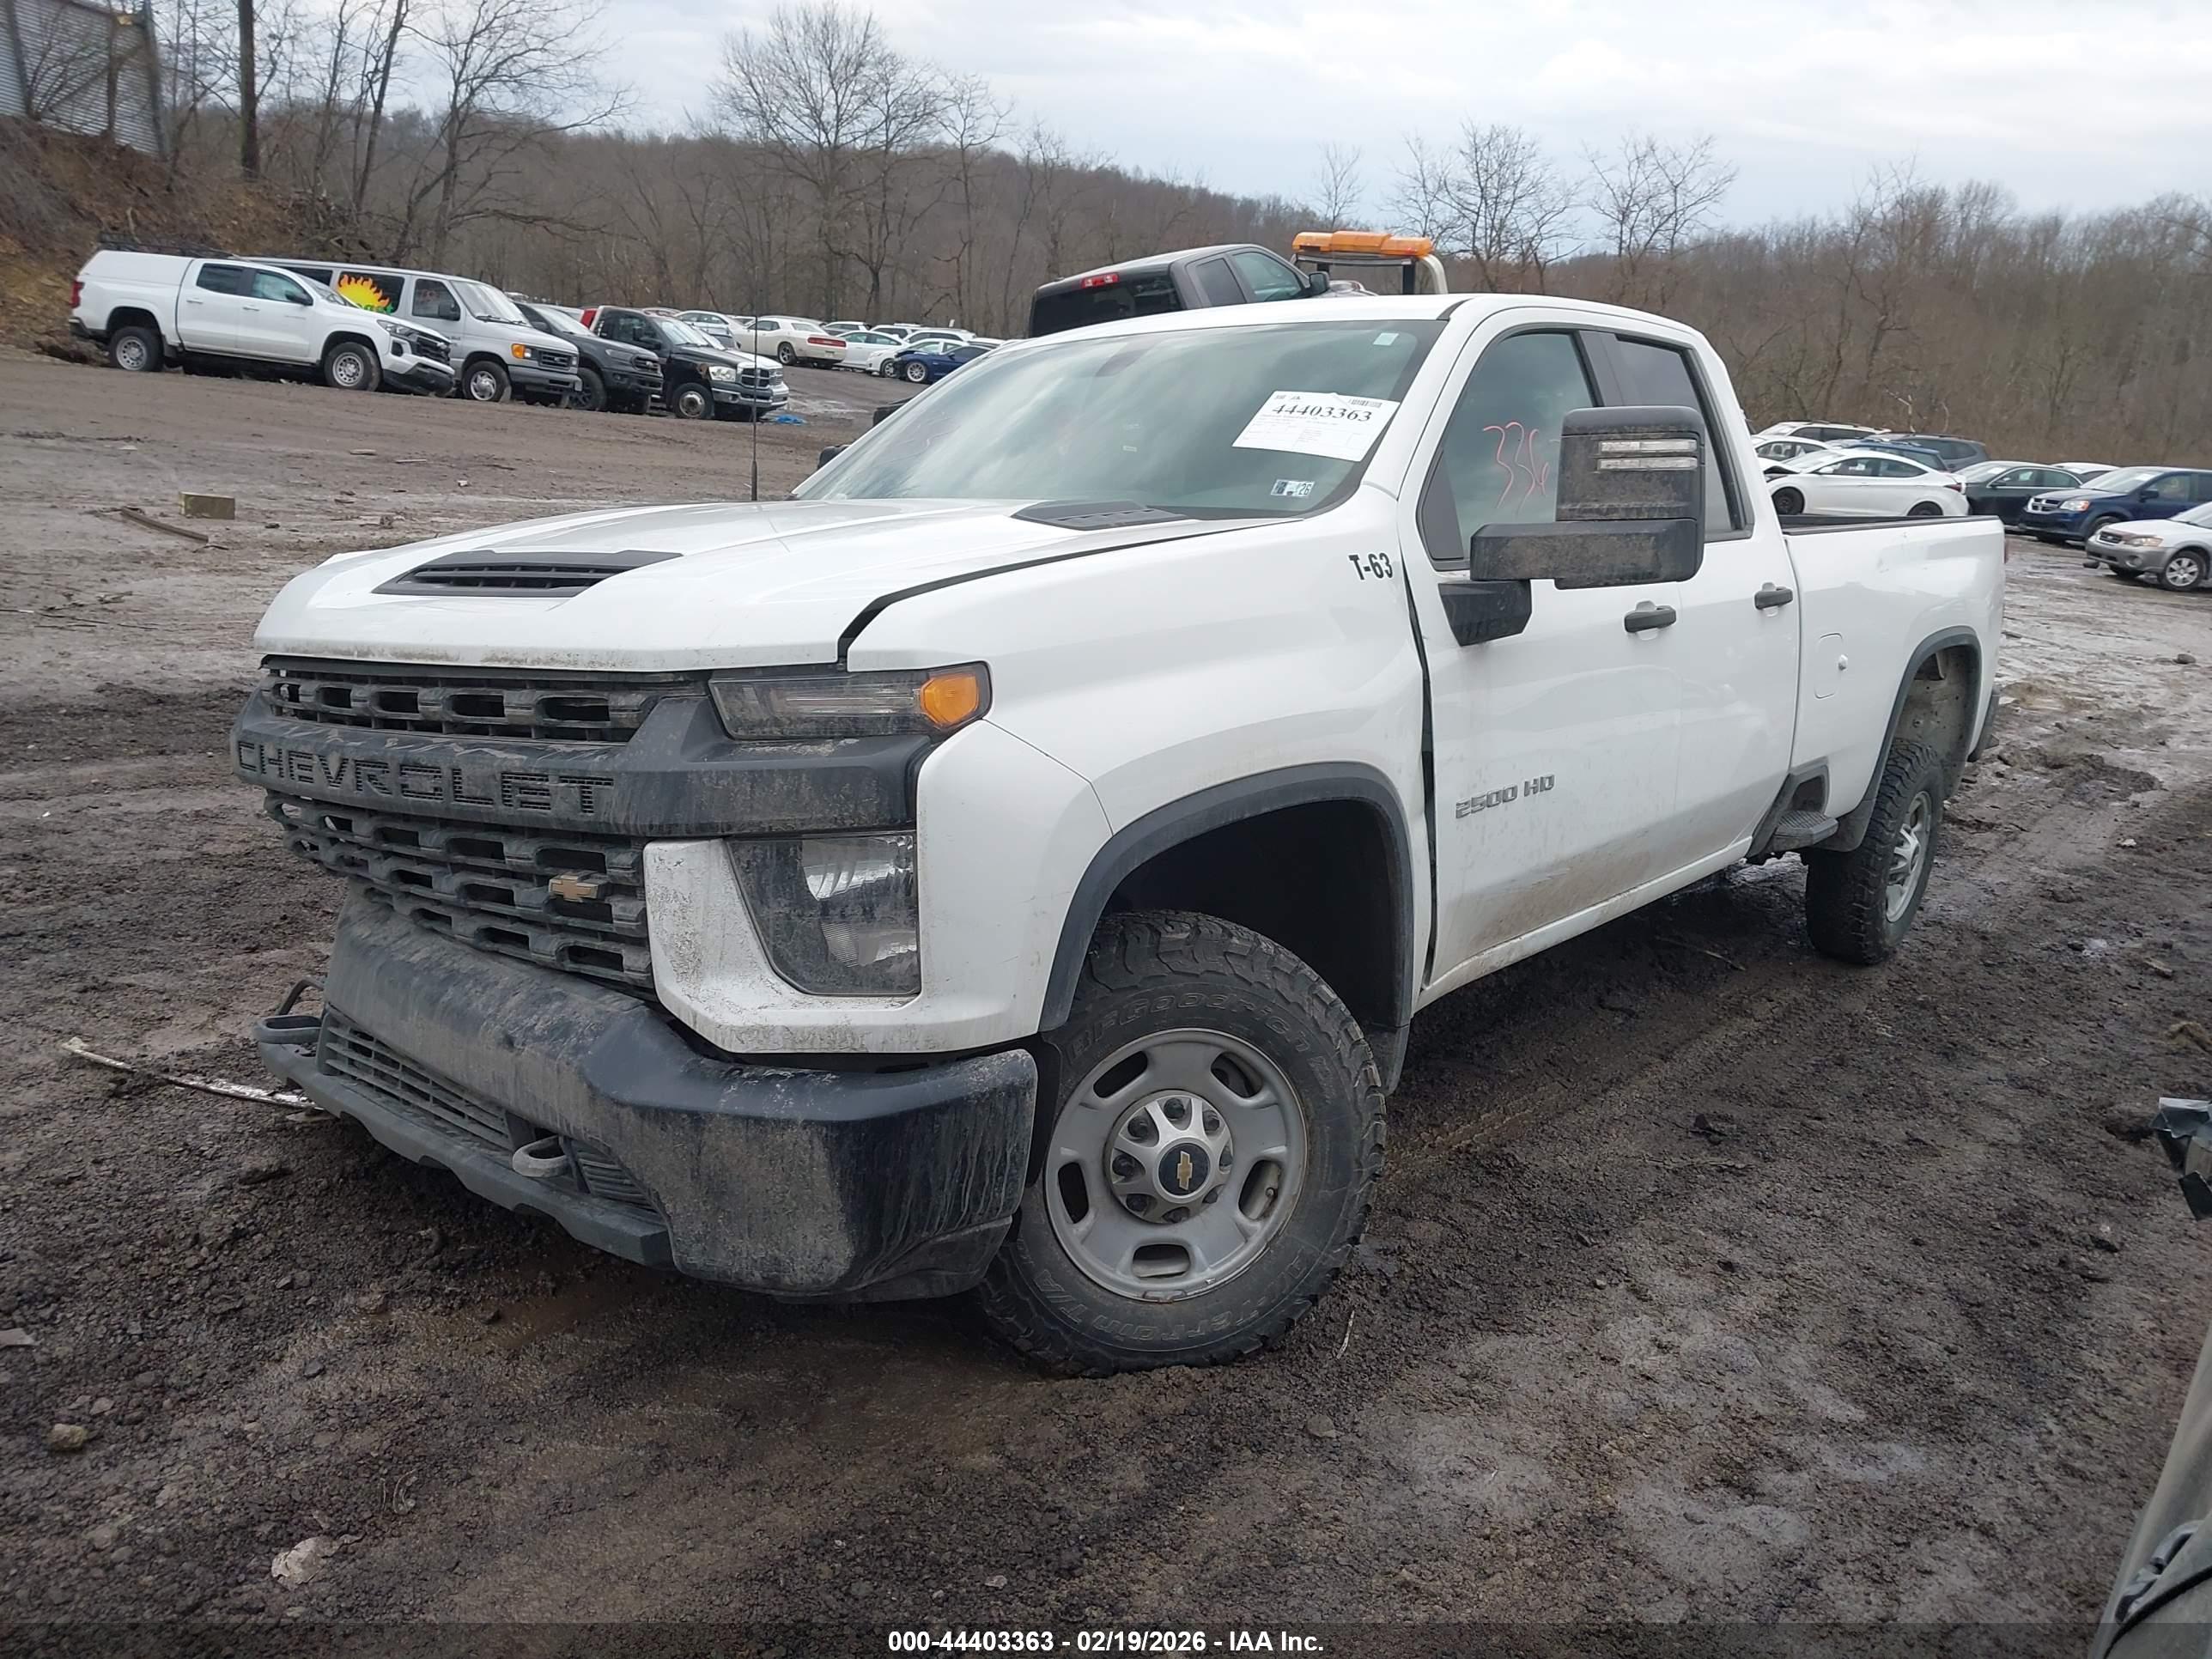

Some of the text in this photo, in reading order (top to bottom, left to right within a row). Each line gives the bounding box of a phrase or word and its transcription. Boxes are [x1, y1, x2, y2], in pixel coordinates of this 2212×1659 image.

[1272, 404, 1372, 422] 44403363
[1348, 552, 1393, 580] T-63
[238, 740, 615, 815] CHEVROLET
[1455, 774, 1555, 819] 2500 HD
